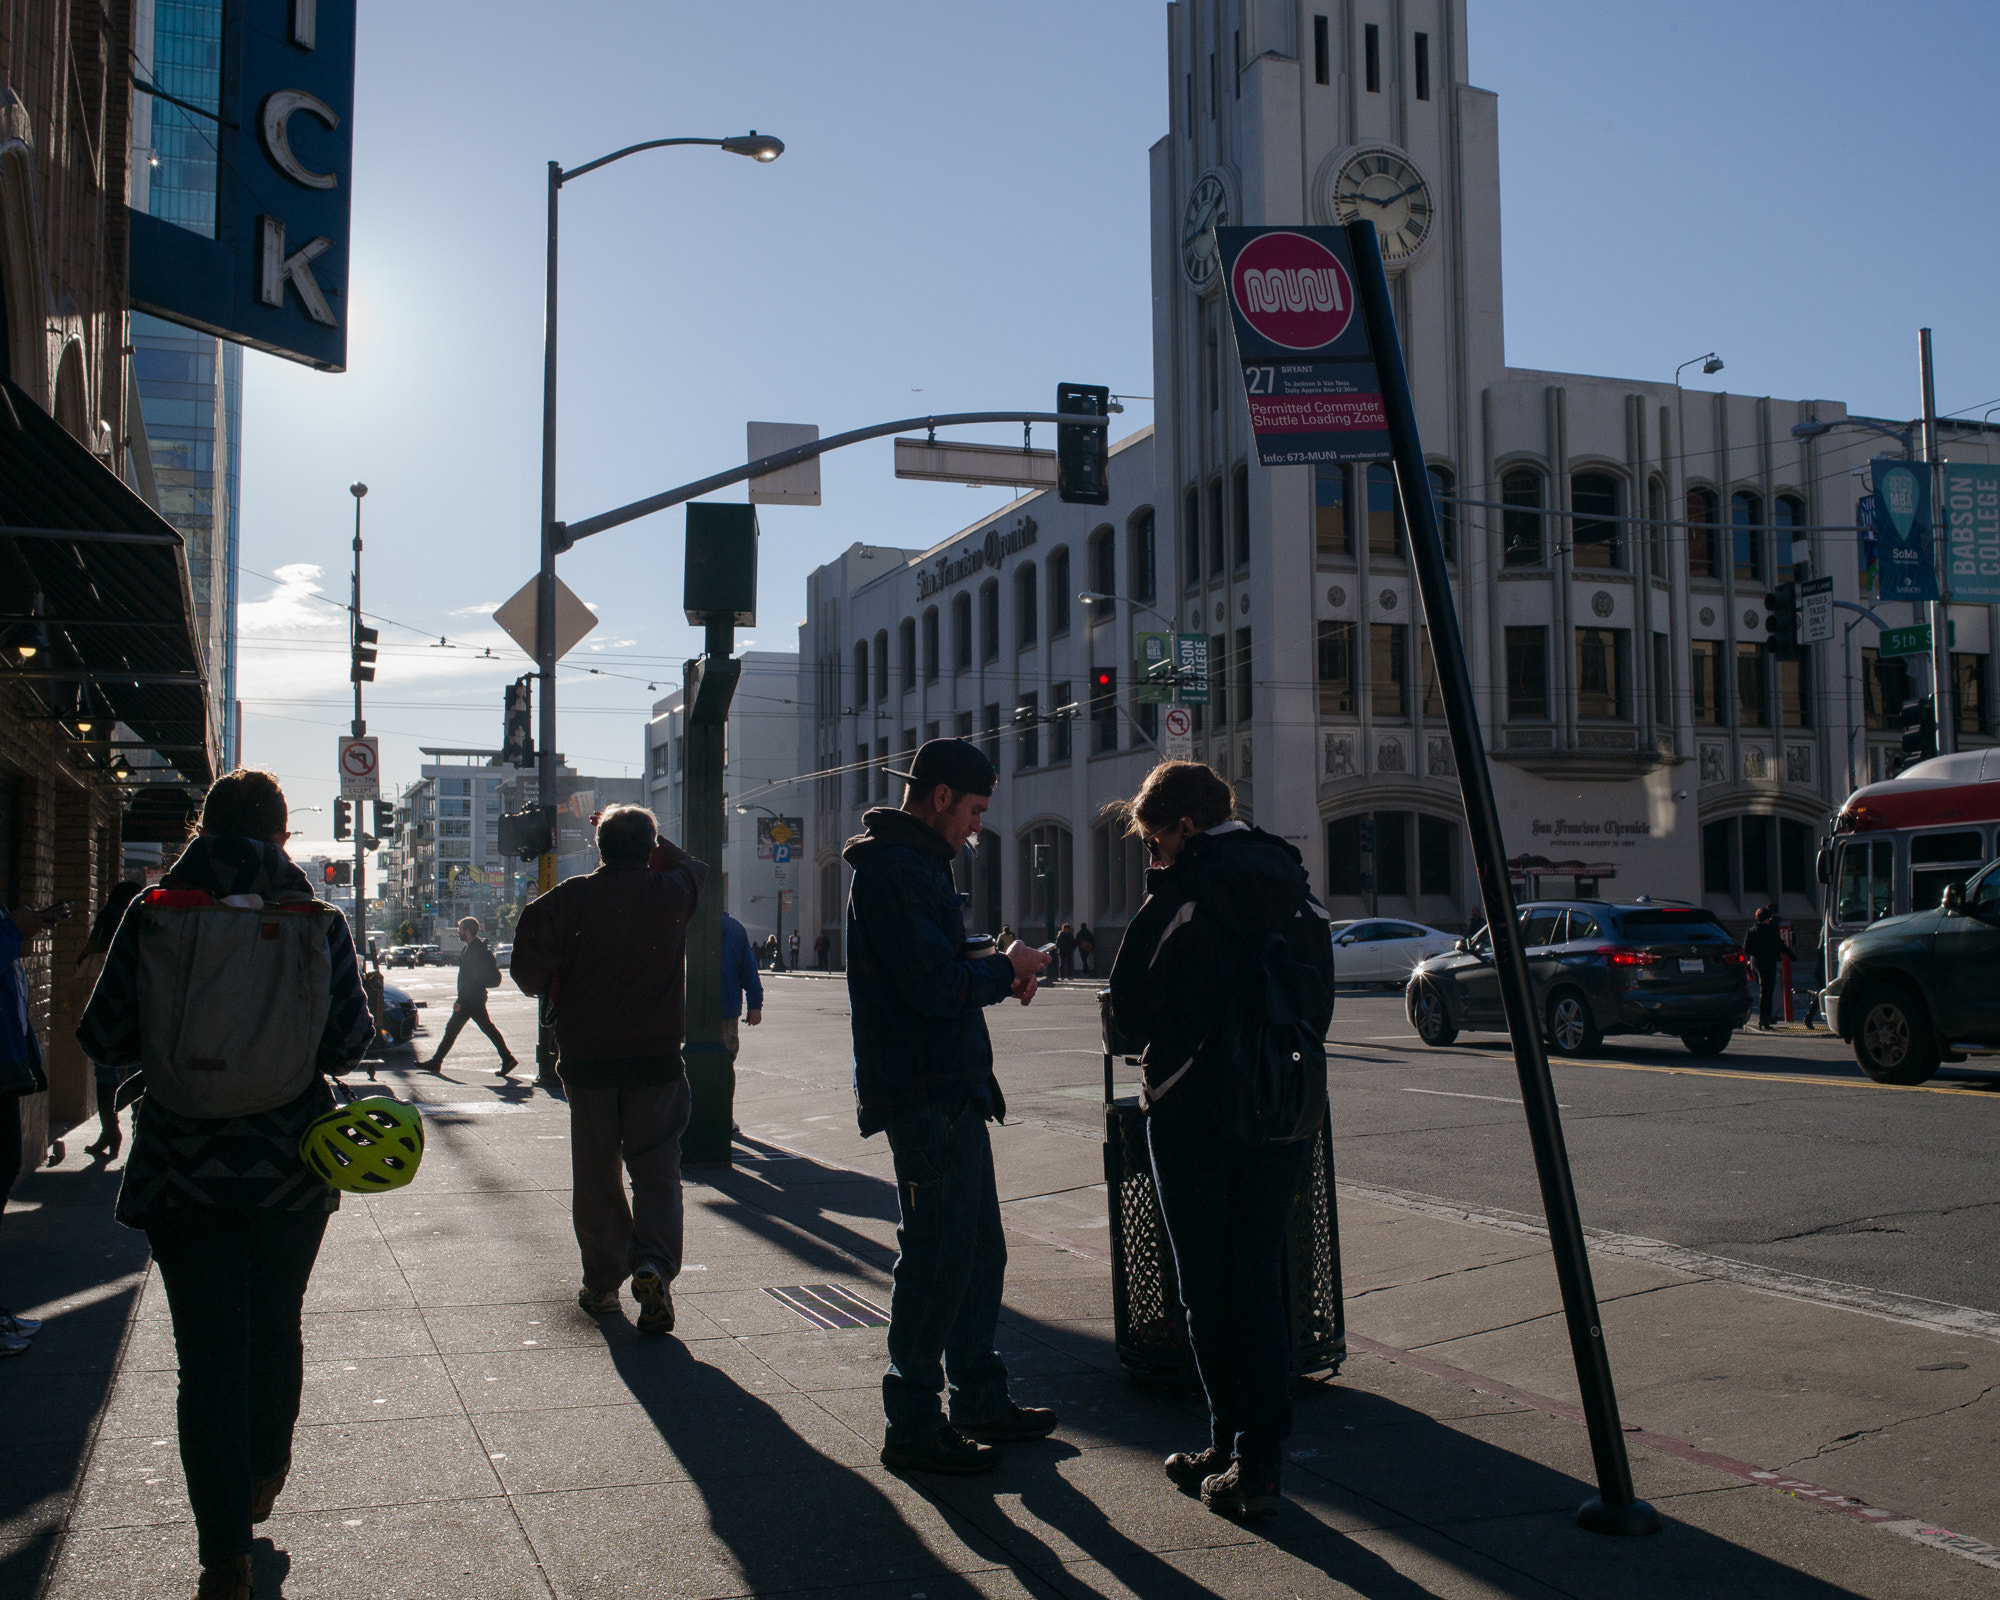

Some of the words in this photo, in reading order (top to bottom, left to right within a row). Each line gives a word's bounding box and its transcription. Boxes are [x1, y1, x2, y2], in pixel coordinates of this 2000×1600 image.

[1243, 268, 1344, 313] MUNI
[1246, 366, 1275, 394] 27
[1281, 365, 1313, 374] BRYANT
[1251, 402, 1312, 415] Permitted
[1314, 400, 1380, 413] Commuter
[1253, 414, 1299, 426] Shuttle
[1301, 413, 1352, 426] Loading
[1353, 411, 1385, 423] Zone
[1263, 453, 1286, 463] Info:
[1287, 451, 1337, 462] 673-MUNI
[1890, 492, 1913, 507] MBA
[1950, 477, 1977, 576] BABSON
[1976, 479, 2000, 576] COLLEGE
[1892, 548, 1918, 559] SoMa
[1809, 605, 1826, 615] TAXIS
[1810, 615, 1826, 626] ONLY
[1892, 632, 1916, 649] 5th
[1531, 819, 1552, 836] San
[1554, 819, 1601, 837] Francisco
[1604, 819, 1650, 837] Chronicle
